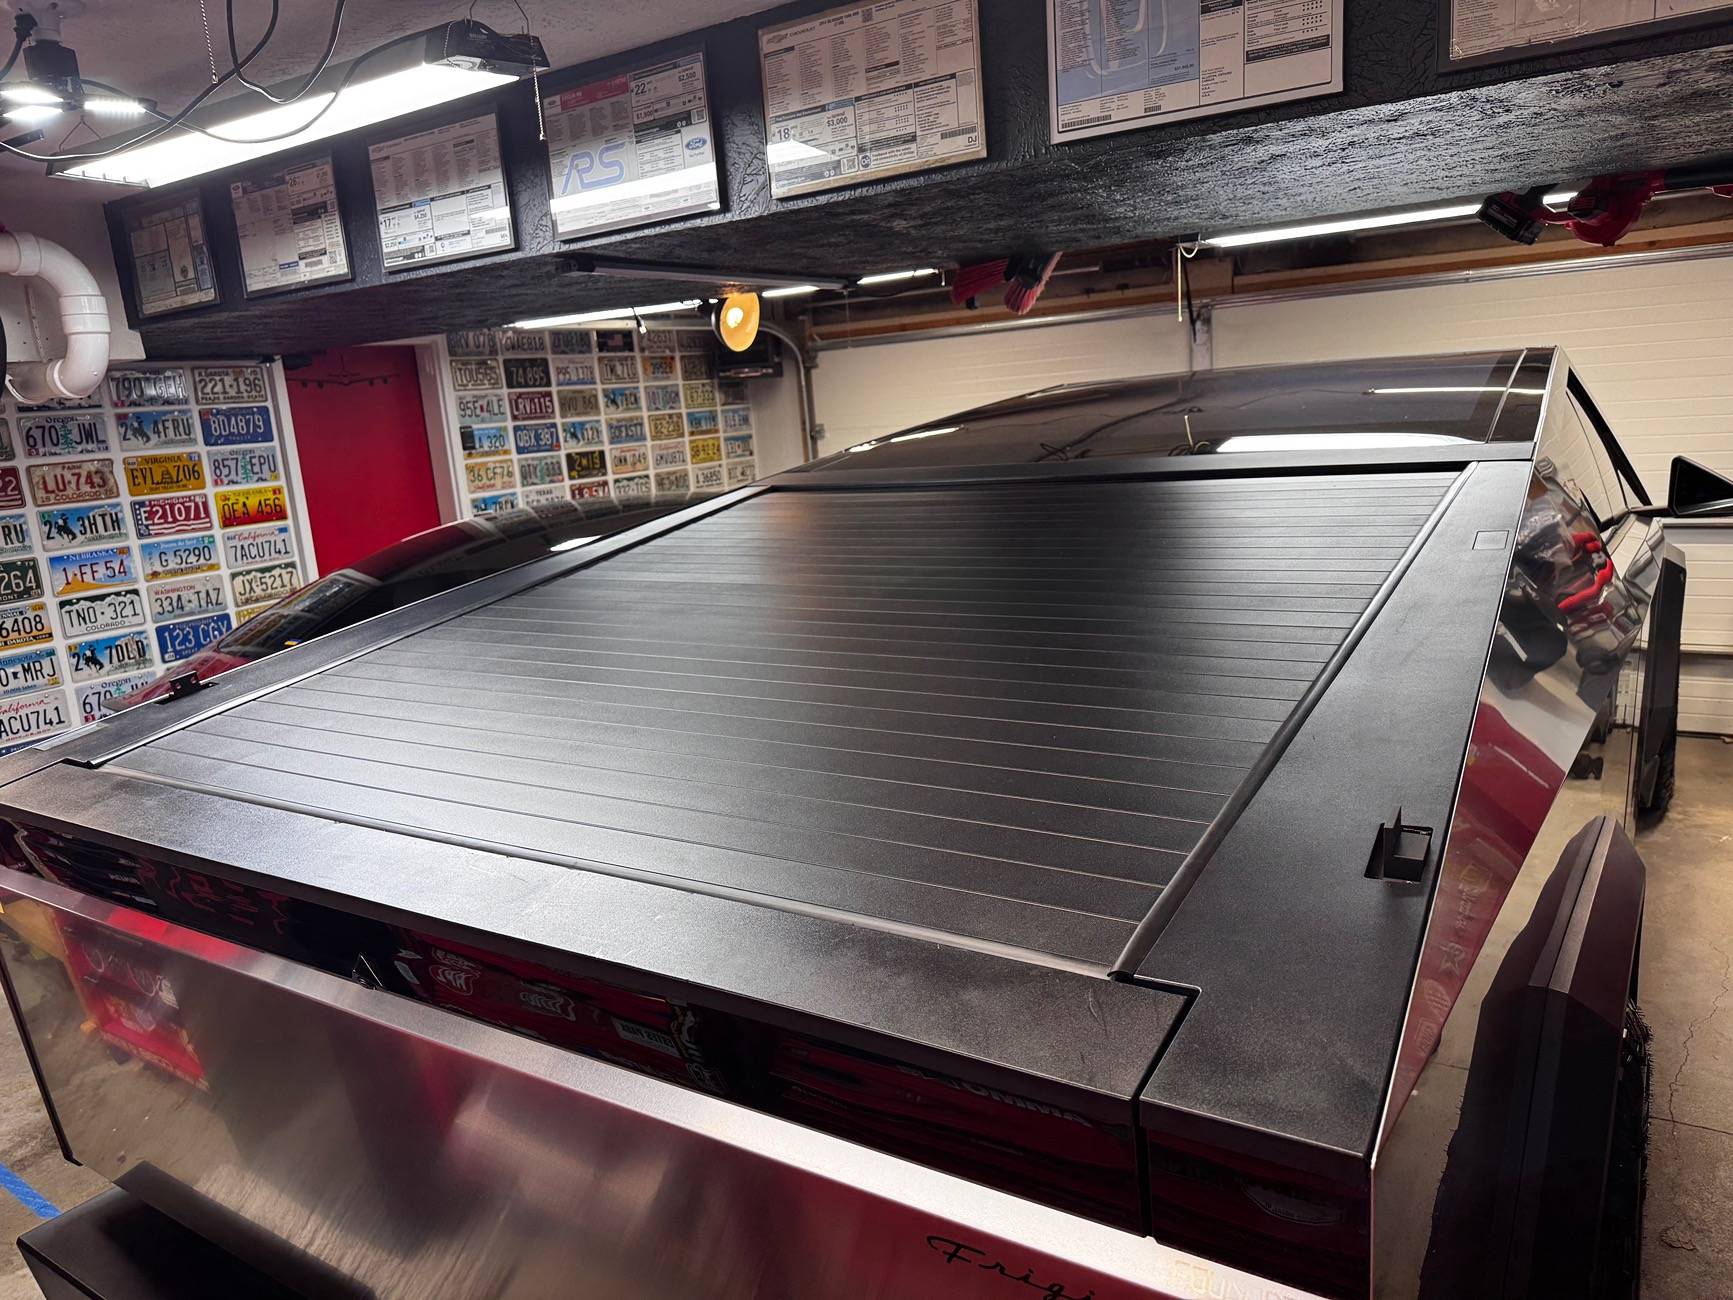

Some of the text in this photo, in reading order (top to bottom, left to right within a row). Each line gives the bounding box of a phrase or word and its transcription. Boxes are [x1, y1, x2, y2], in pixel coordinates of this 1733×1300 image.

[634, 82, 647, 96] 22
[826, 116, 848, 127] $3,000
[777, 127, 790, 141] 18
[561, 141, 626, 195] RS
[383, 218, 391, 229] 17
[46, 416, 79, 425] Oregon
[152, 417, 192, 440] 4FRU
[25, 422, 107, 448] 670 JWL
[144, 456, 183, 465] VIRGINIA
[213, 454, 277, 478] 857 EPU
[130, 467, 158, 487] EVL
[54, 490, 102, 502] COLORADO
[257, 496, 283, 516] 456
[76, 512, 122, 536] 3HTH
[69, 551, 114, 561] NEBRASKA
[158, 545, 212, 568] G 5290
[230, 538, 291, 563] 7ACU741
[104, 559, 128, 579] 54
[154, 584, 196, 596] WASHINGTON
[0, 614, 45, 639] 6408
[85, 620, 126, 632] COLORADO
[164, 627, 196, 653] 123
[21, 658, 57, 684] MRJ
[101, 677, 132, 689] Oregon
